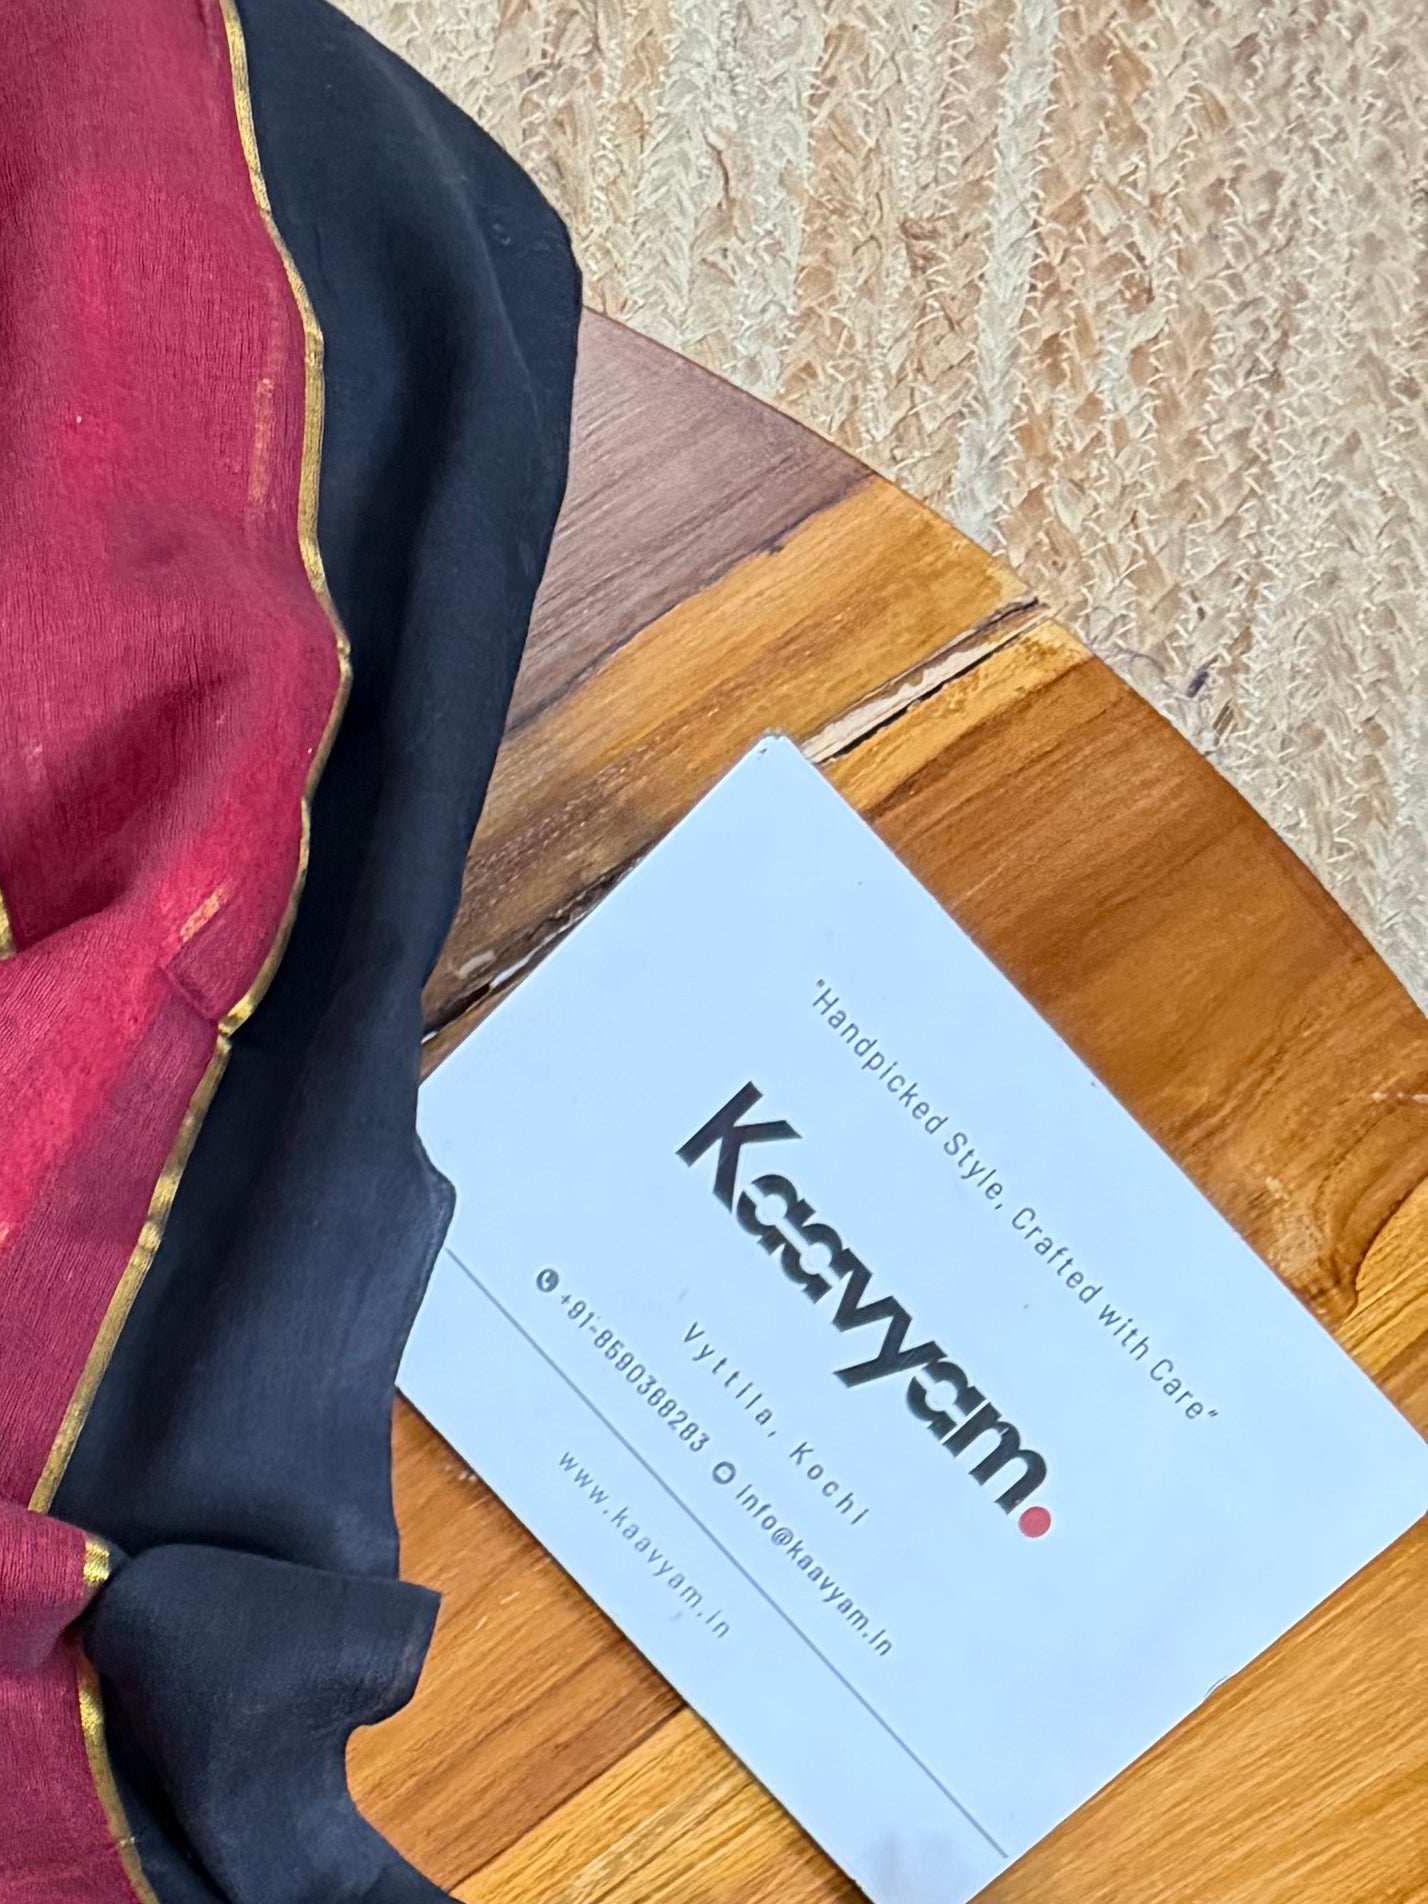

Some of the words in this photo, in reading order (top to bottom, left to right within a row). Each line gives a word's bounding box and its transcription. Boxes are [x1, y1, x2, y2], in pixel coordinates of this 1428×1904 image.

[1010, 1206, 1105, 1305] Crafted
[1097, 1302, 1150, 1362] with
[682, 1321, 777, 1439] Vyttila,
[787, 1440, 871, 1526] Kochi
[557, 1450, 731, 1640] www.kaavyam.in
[734, 1482, 893, 1658] info@kaavyam.in
